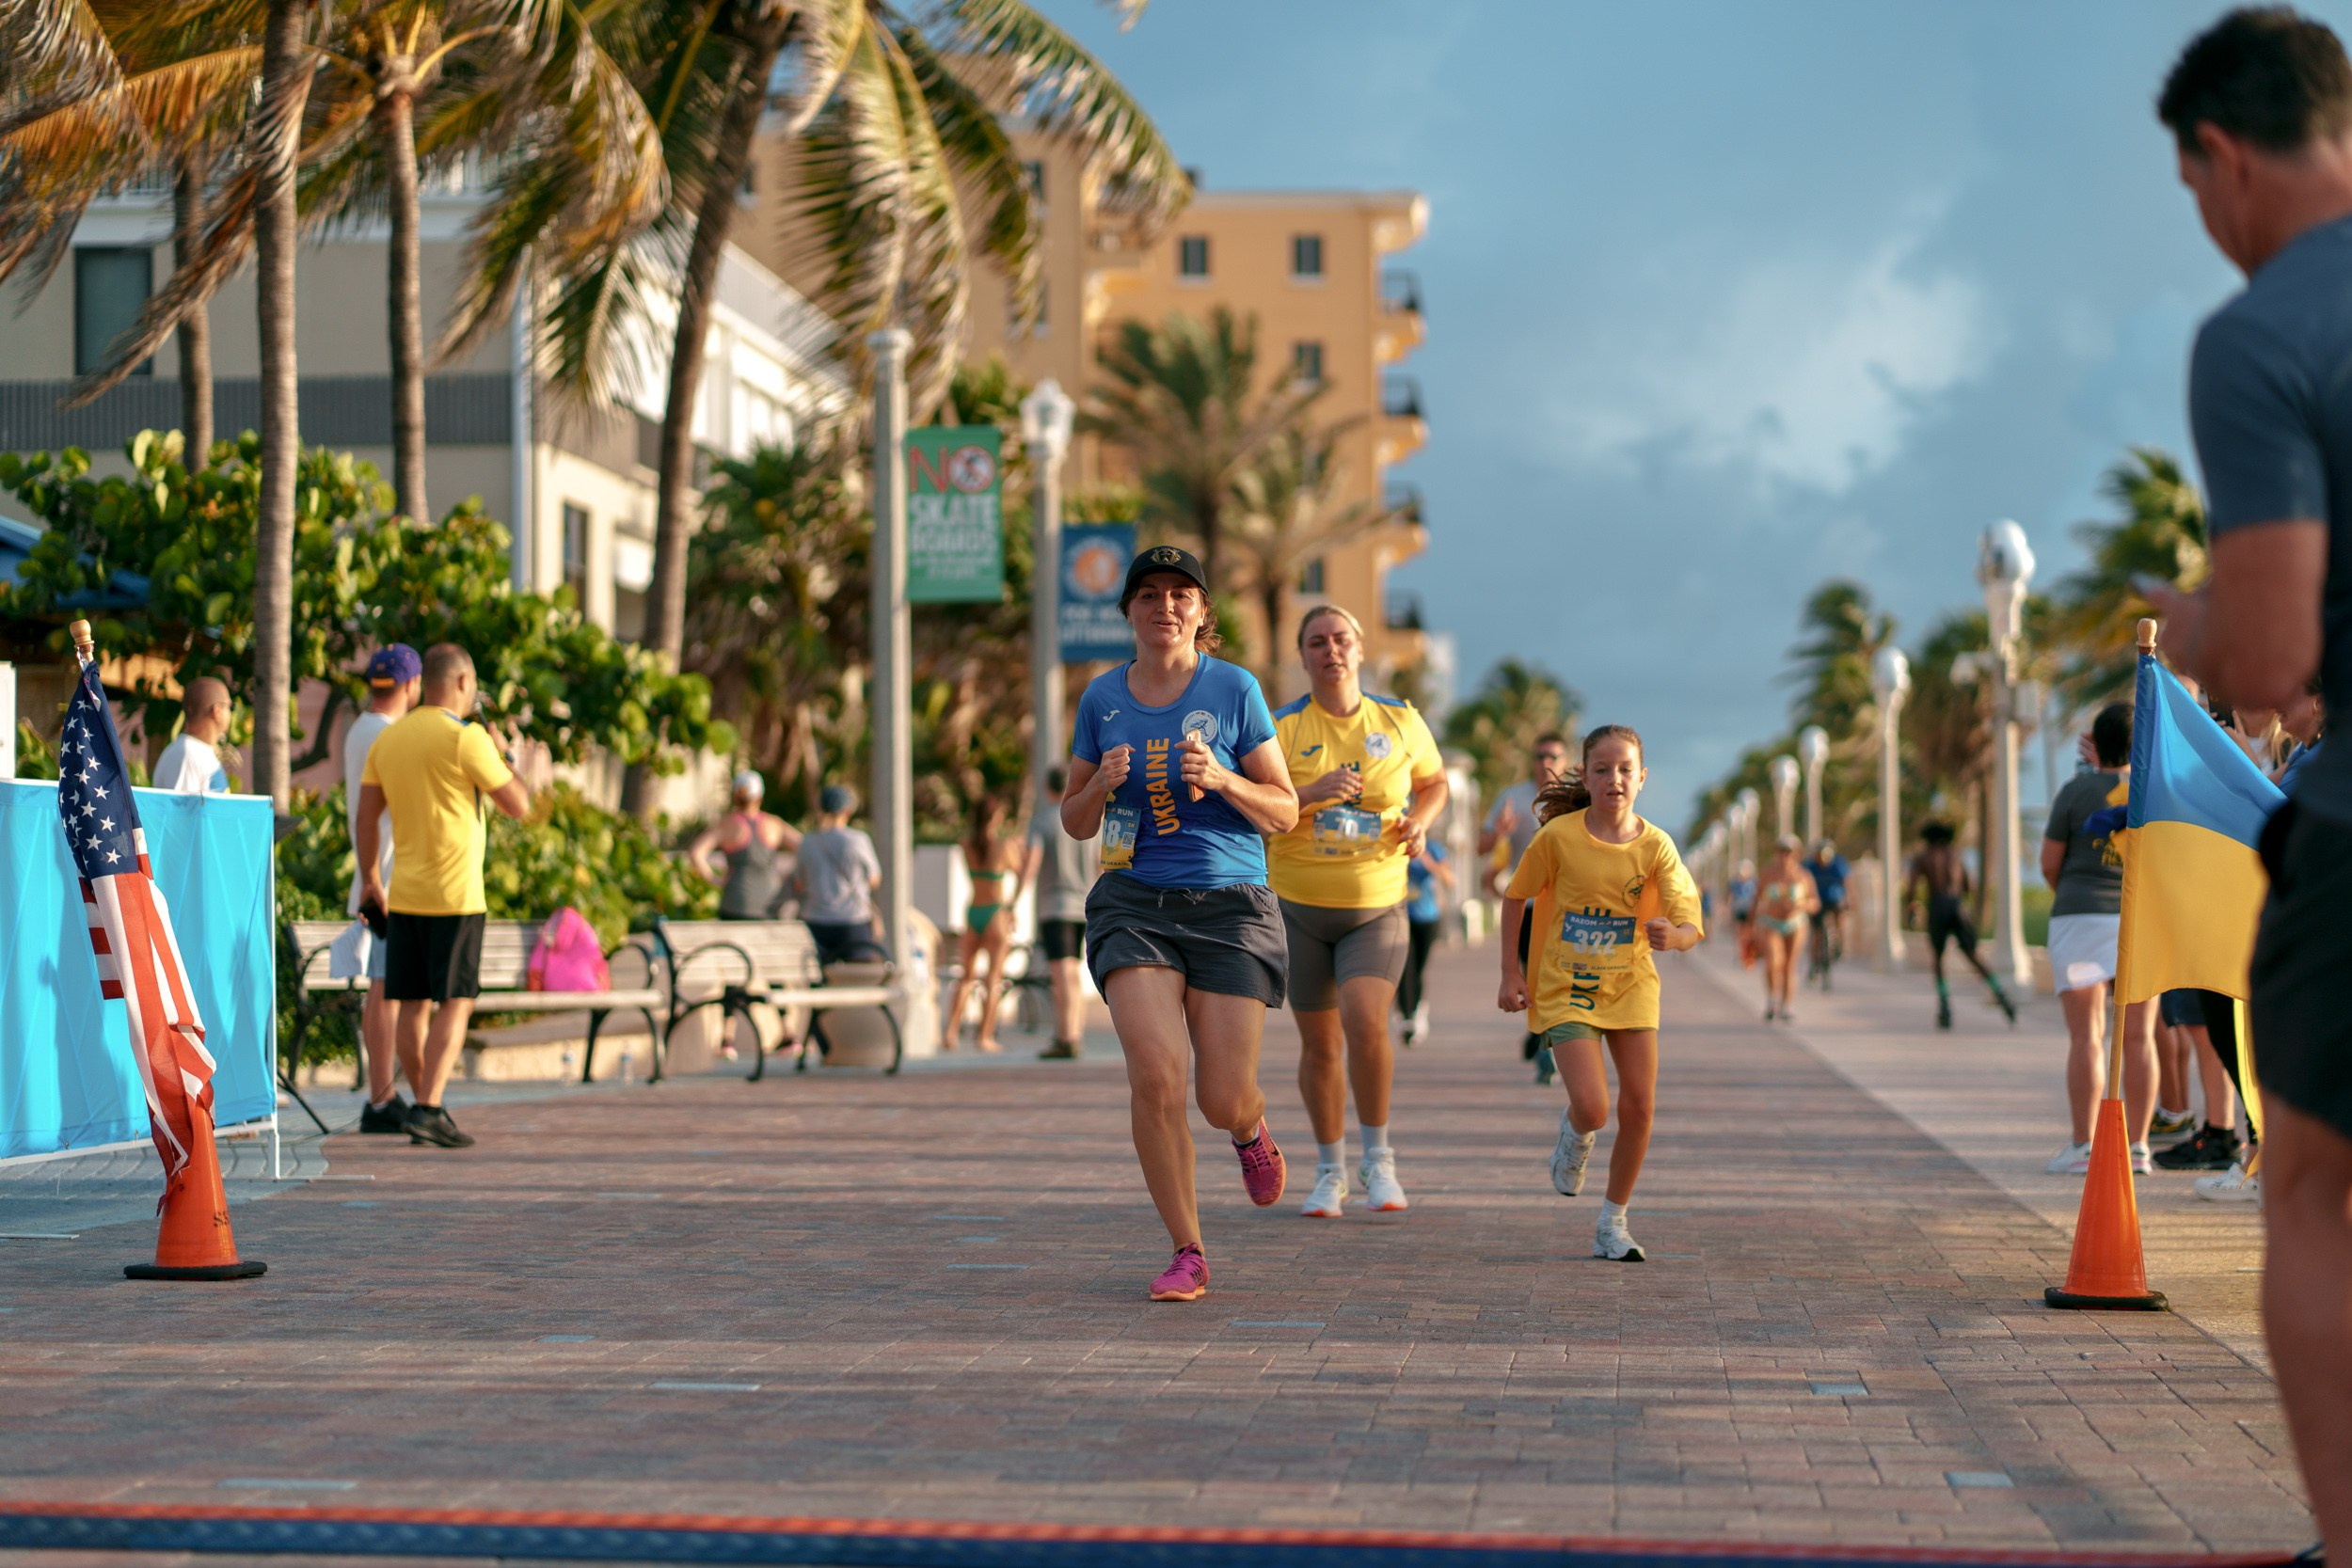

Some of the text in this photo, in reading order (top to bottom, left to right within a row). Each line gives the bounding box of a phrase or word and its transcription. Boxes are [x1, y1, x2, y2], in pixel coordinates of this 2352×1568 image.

[909, 445, 996, 494] NO
[1146, 738, 1180, 835] UKRAINE
[1117, 808, 1134, 816] RUN
[1570, 915, 1597, 927] RAZOM
[1573, 928, 1617, 954] 322
